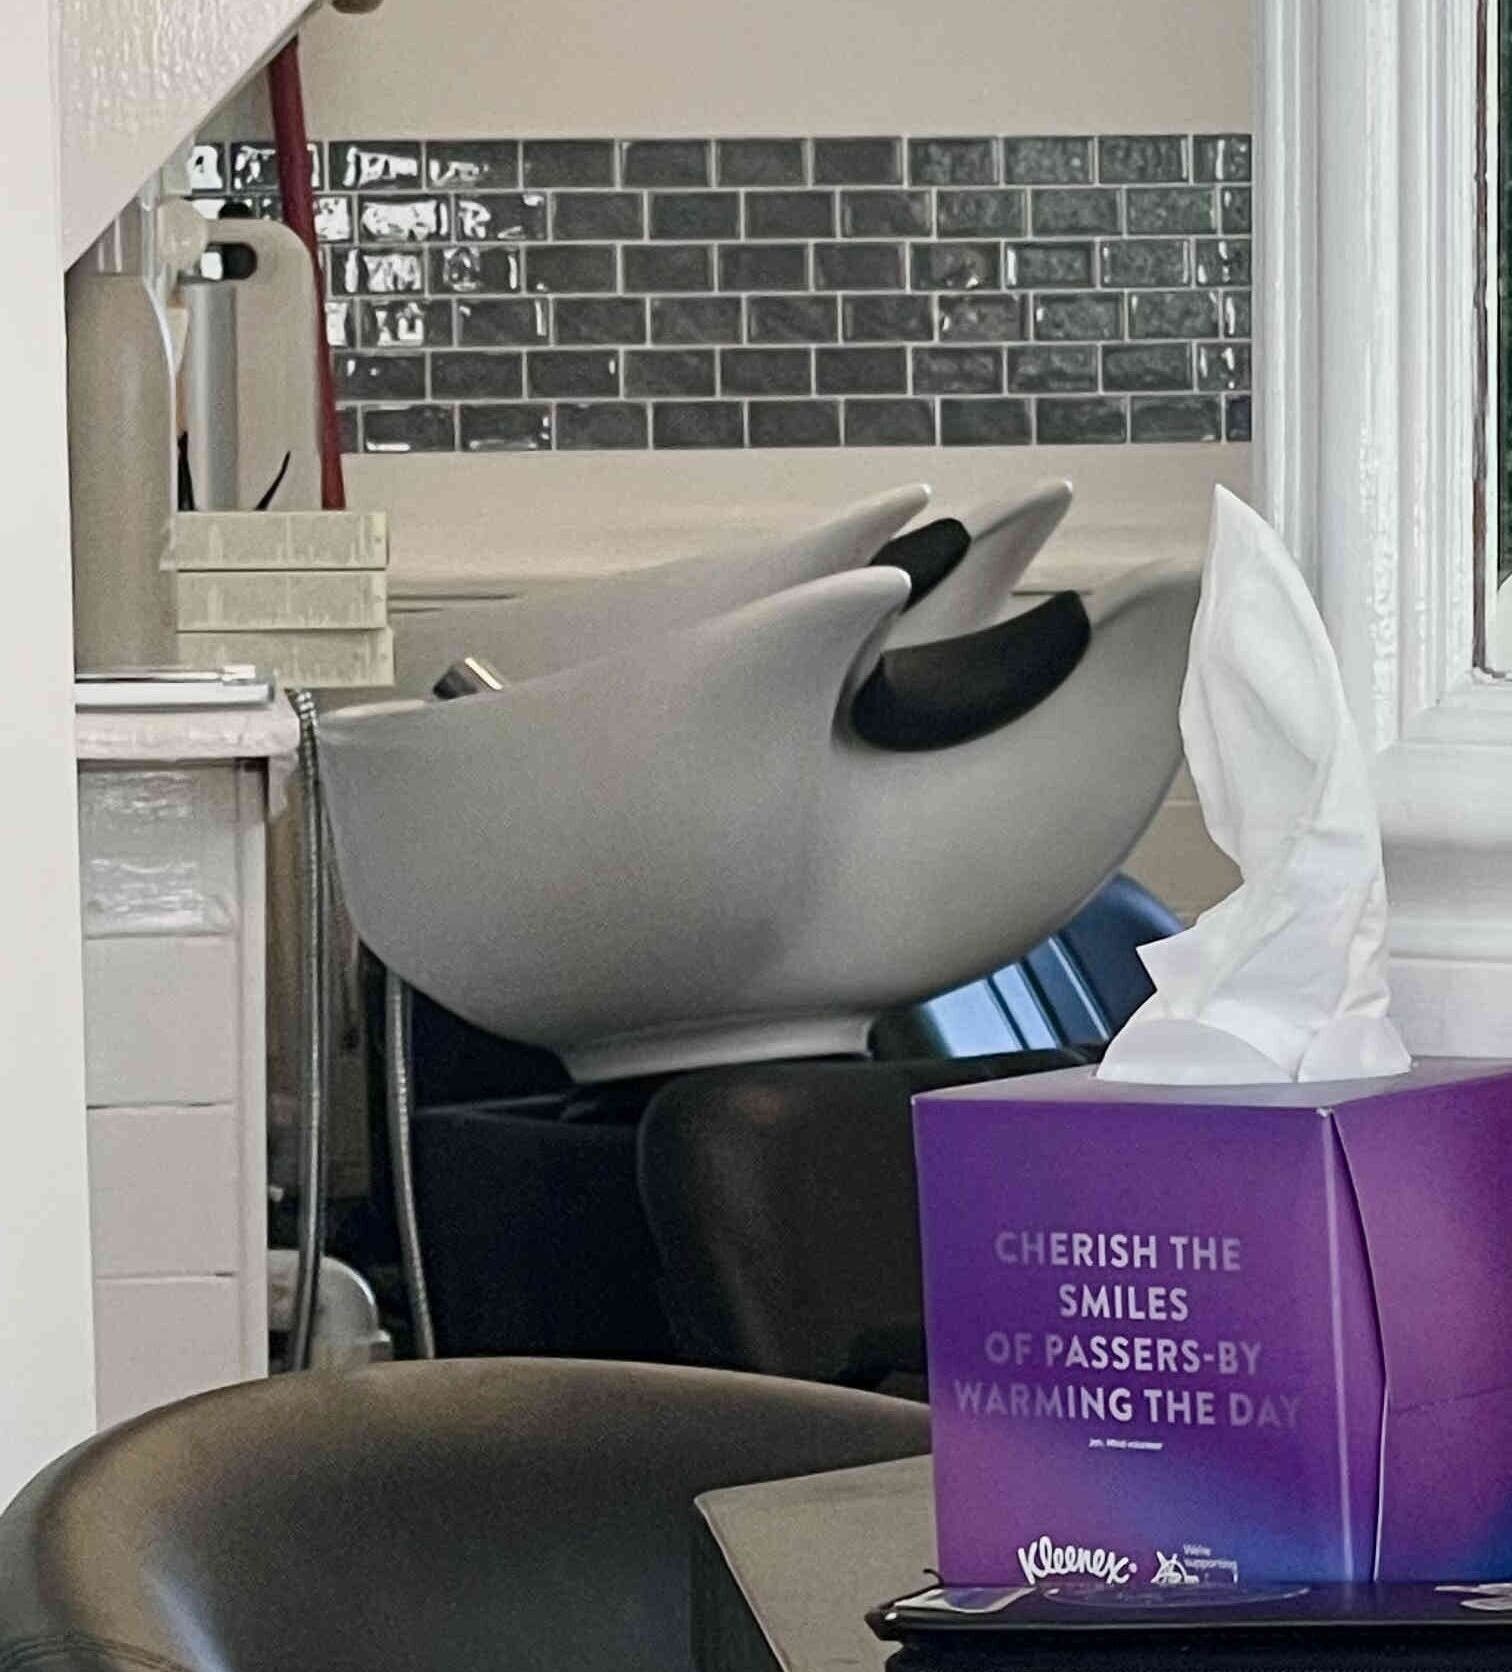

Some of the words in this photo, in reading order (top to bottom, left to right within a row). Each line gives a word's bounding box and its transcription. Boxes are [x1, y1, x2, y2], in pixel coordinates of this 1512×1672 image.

[994, 1232, 1157, 1270] CHERISH
[1169, 1235, 1242, 1272] THE
[1058, 1283, 1190, 1322] SMILES
[984, 1331, 1034, 1367] OF
[1044, 1334, 1263, 1377] PASSERS-BY
[952, 1378, 1134, 1423] WARMING
[1142, 1387, 1217, 1426] THE
[1228, 1394, 1302, 1429] DAY
[1017, 1535, 1131, 1585] Kleenex
